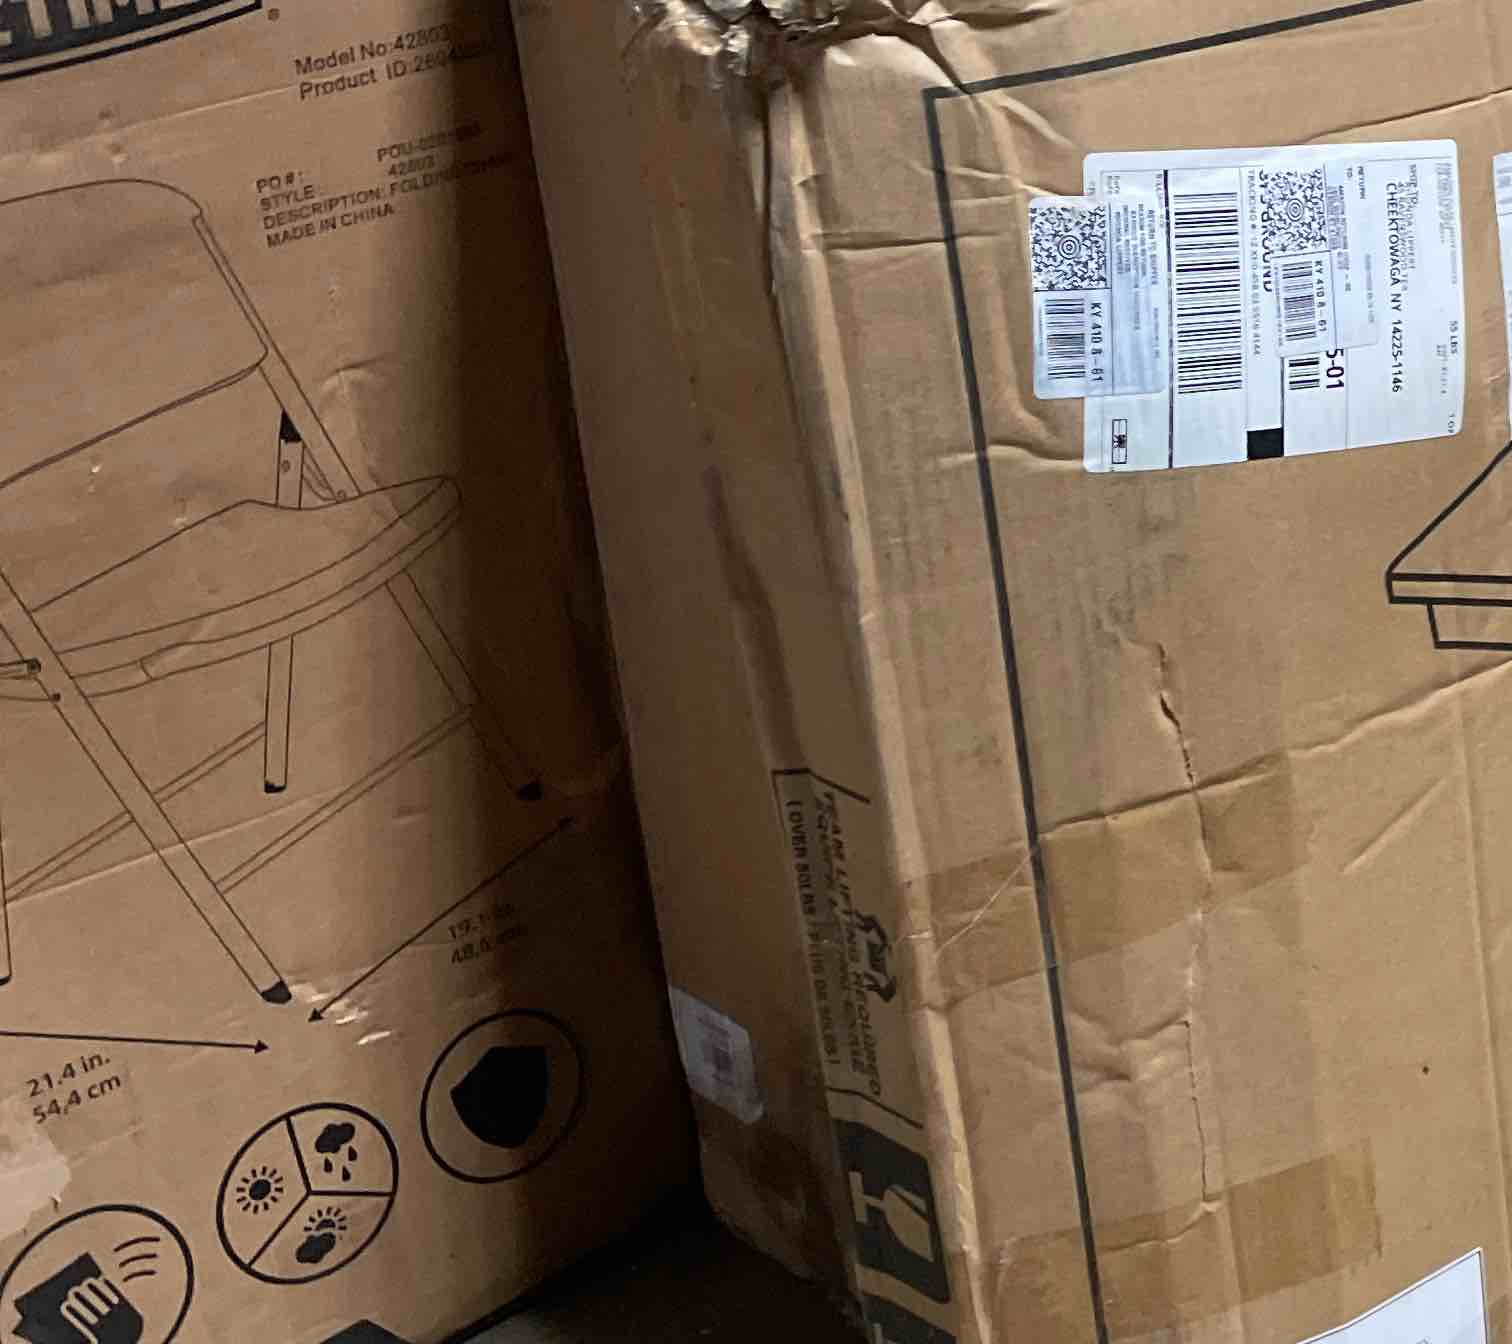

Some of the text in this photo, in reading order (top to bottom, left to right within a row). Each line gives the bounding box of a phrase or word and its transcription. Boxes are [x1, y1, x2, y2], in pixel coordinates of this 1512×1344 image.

[295, 44, 355, 77] Model
[299, 68, 378, 101] Product
[260, 185, 314, 211] STYLE
[266, 222, 317, 248] MADE
[340, 202, 395, 230] CHINA
[1386, 182, 1404, 394] CHEEKTOWAGA NY 14225-1146
[1090, 302, 1102, 318] KY
[26, 1054, 112, 1099] 21.4 in.
[86, 1074, 123, 1100] cm
